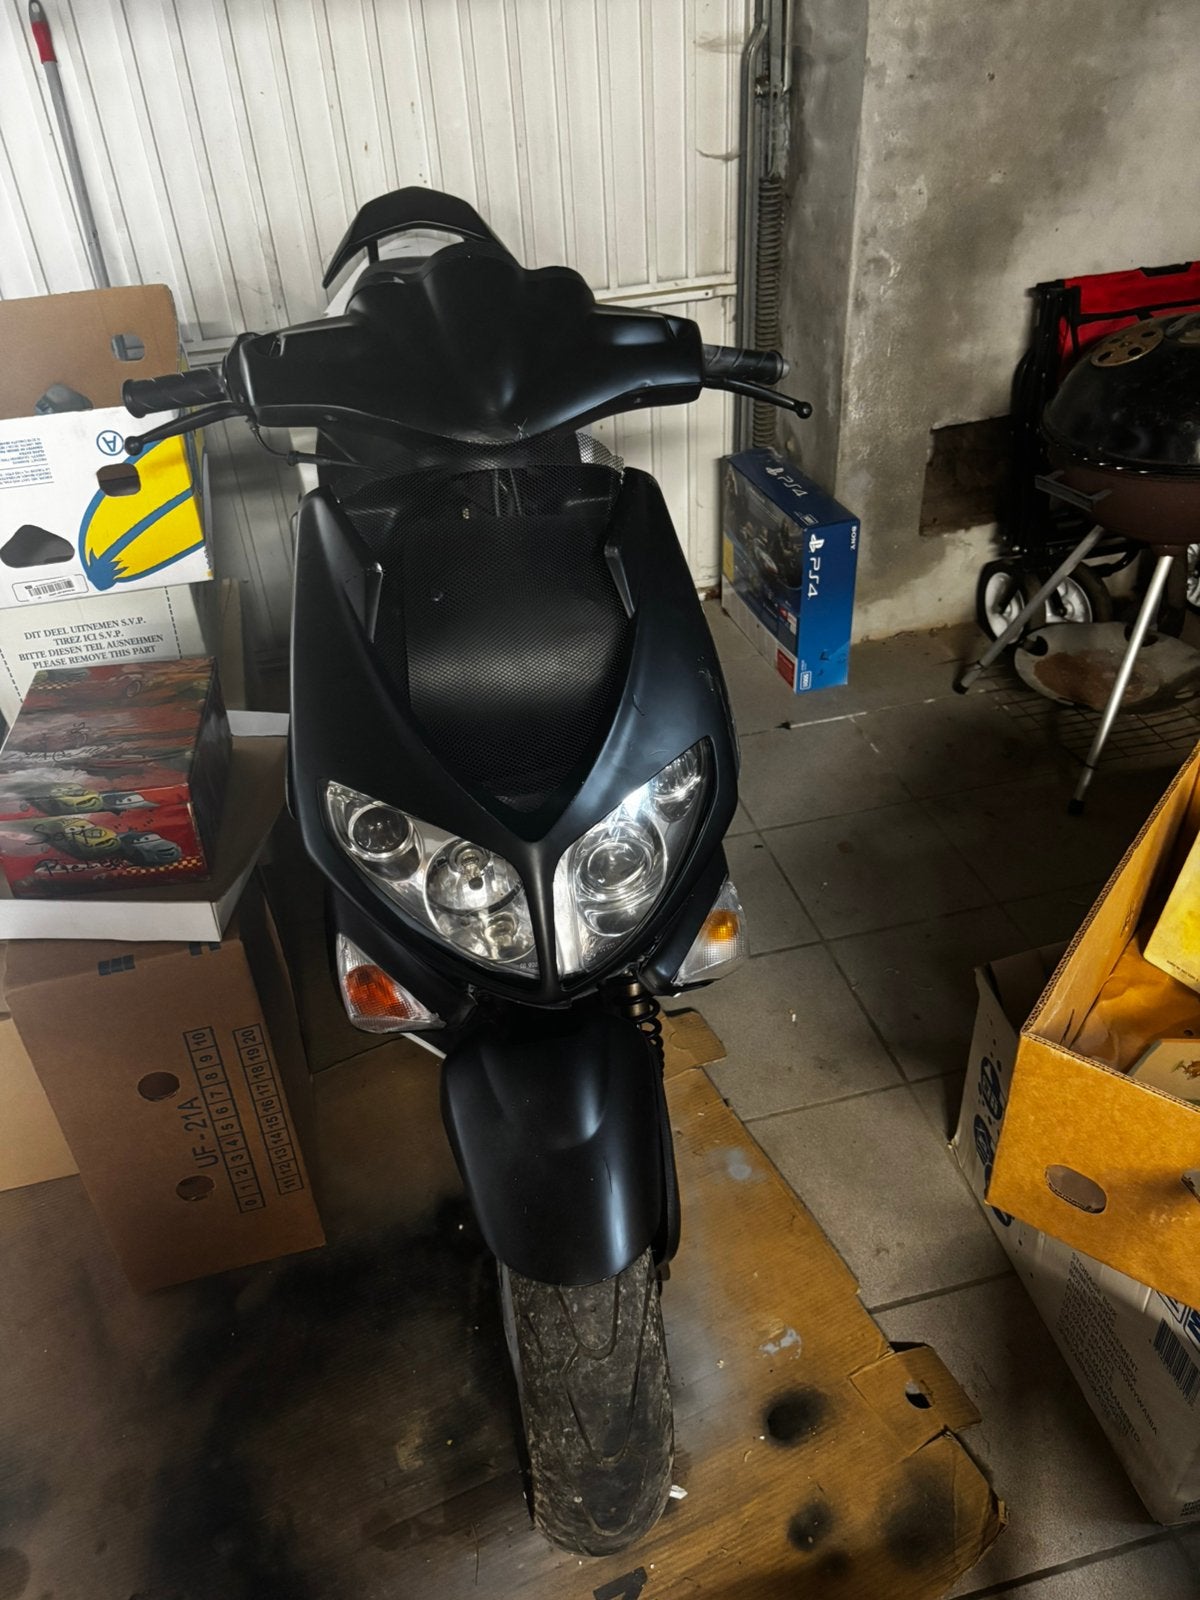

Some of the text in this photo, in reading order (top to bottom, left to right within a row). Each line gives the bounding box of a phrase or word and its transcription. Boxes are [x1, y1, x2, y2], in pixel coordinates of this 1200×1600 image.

[778, 476, 808, 497] PS4
[808, 557, 821, 598] PS4
[24, 617, 146, 640] DIT DEEL UITNEMEN S.V.P.
[53, 630, 124, 646] TIREZ ICI S.V.P.
[19, 634, 164, 661] BITTE DIESEN TEIL AUSNEHMEN
[33, 646, 156, 669] PLEASE REMOVE THIS PART
[192, 1032, 206, 1046] 10
[200, 1055, 212, 1063] 9
[205, 1072, 218, 1081] 8
[216, 1107, 228, 1115] 6
[243, 1030, 296, 1190] 11 12 13 14 15 16 17 18 19 20
[221, 1123, 234, 1131] 5
[226, 1139, 238, 1147] 4
[236, 1168, 248, 1177] 2
